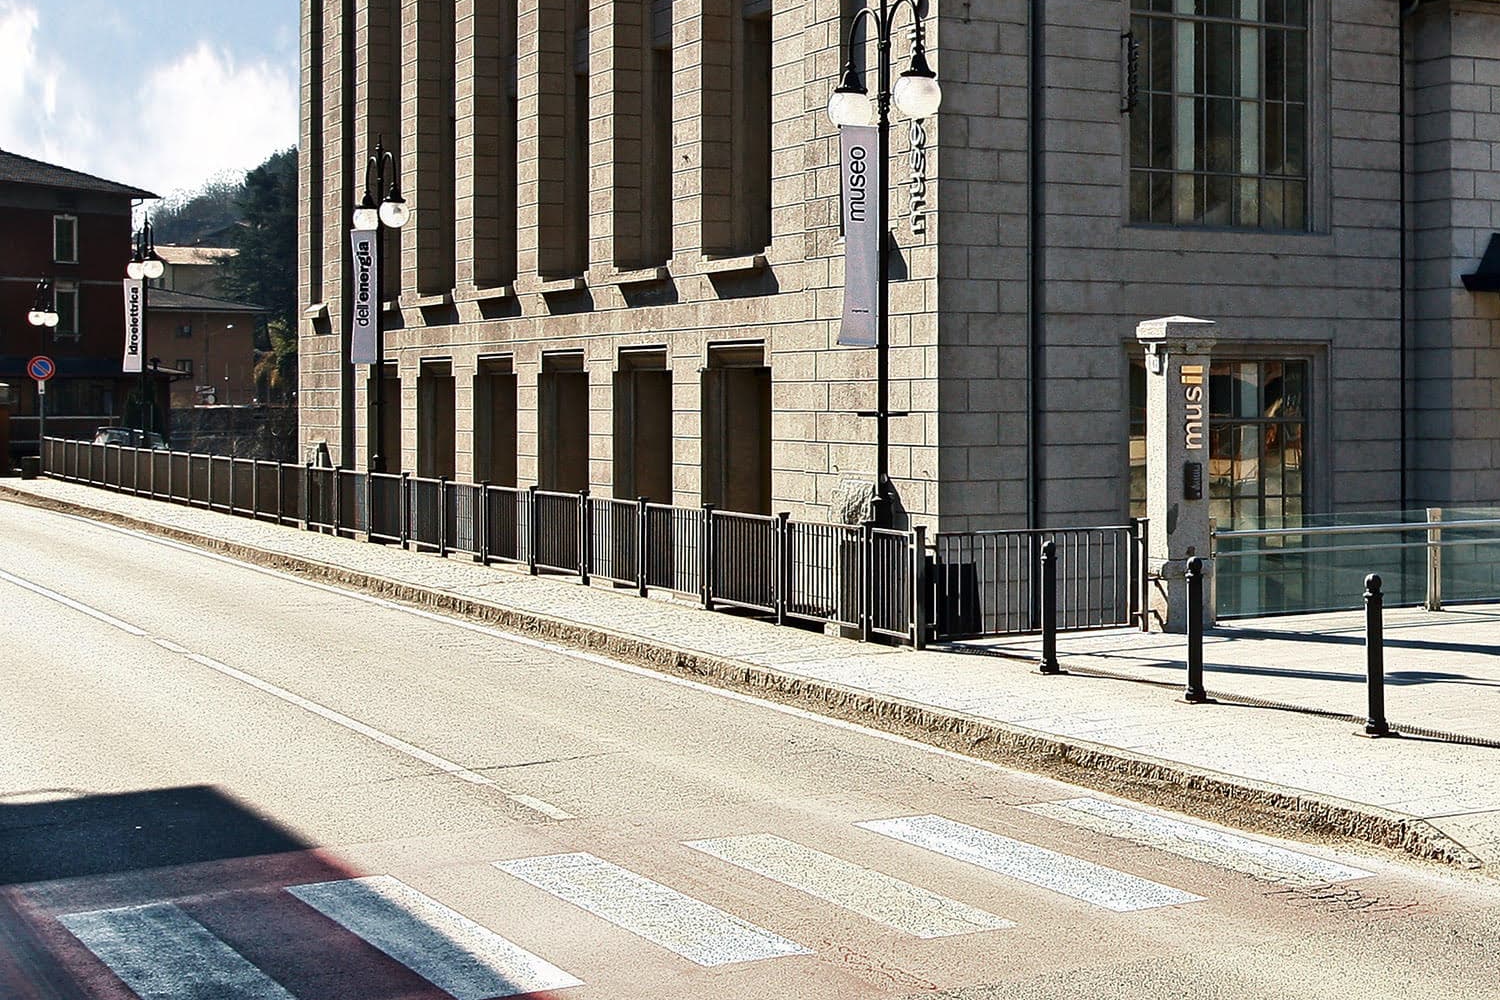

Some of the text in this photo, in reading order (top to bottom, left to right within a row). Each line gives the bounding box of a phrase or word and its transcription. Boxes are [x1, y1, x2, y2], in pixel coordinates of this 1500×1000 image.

[849, 146, 866, 222] museo
[910, 116, 925, 235] muse
[356, 241, 372, 327] dell'energia
[1180, 365, 1203, 449] musil
